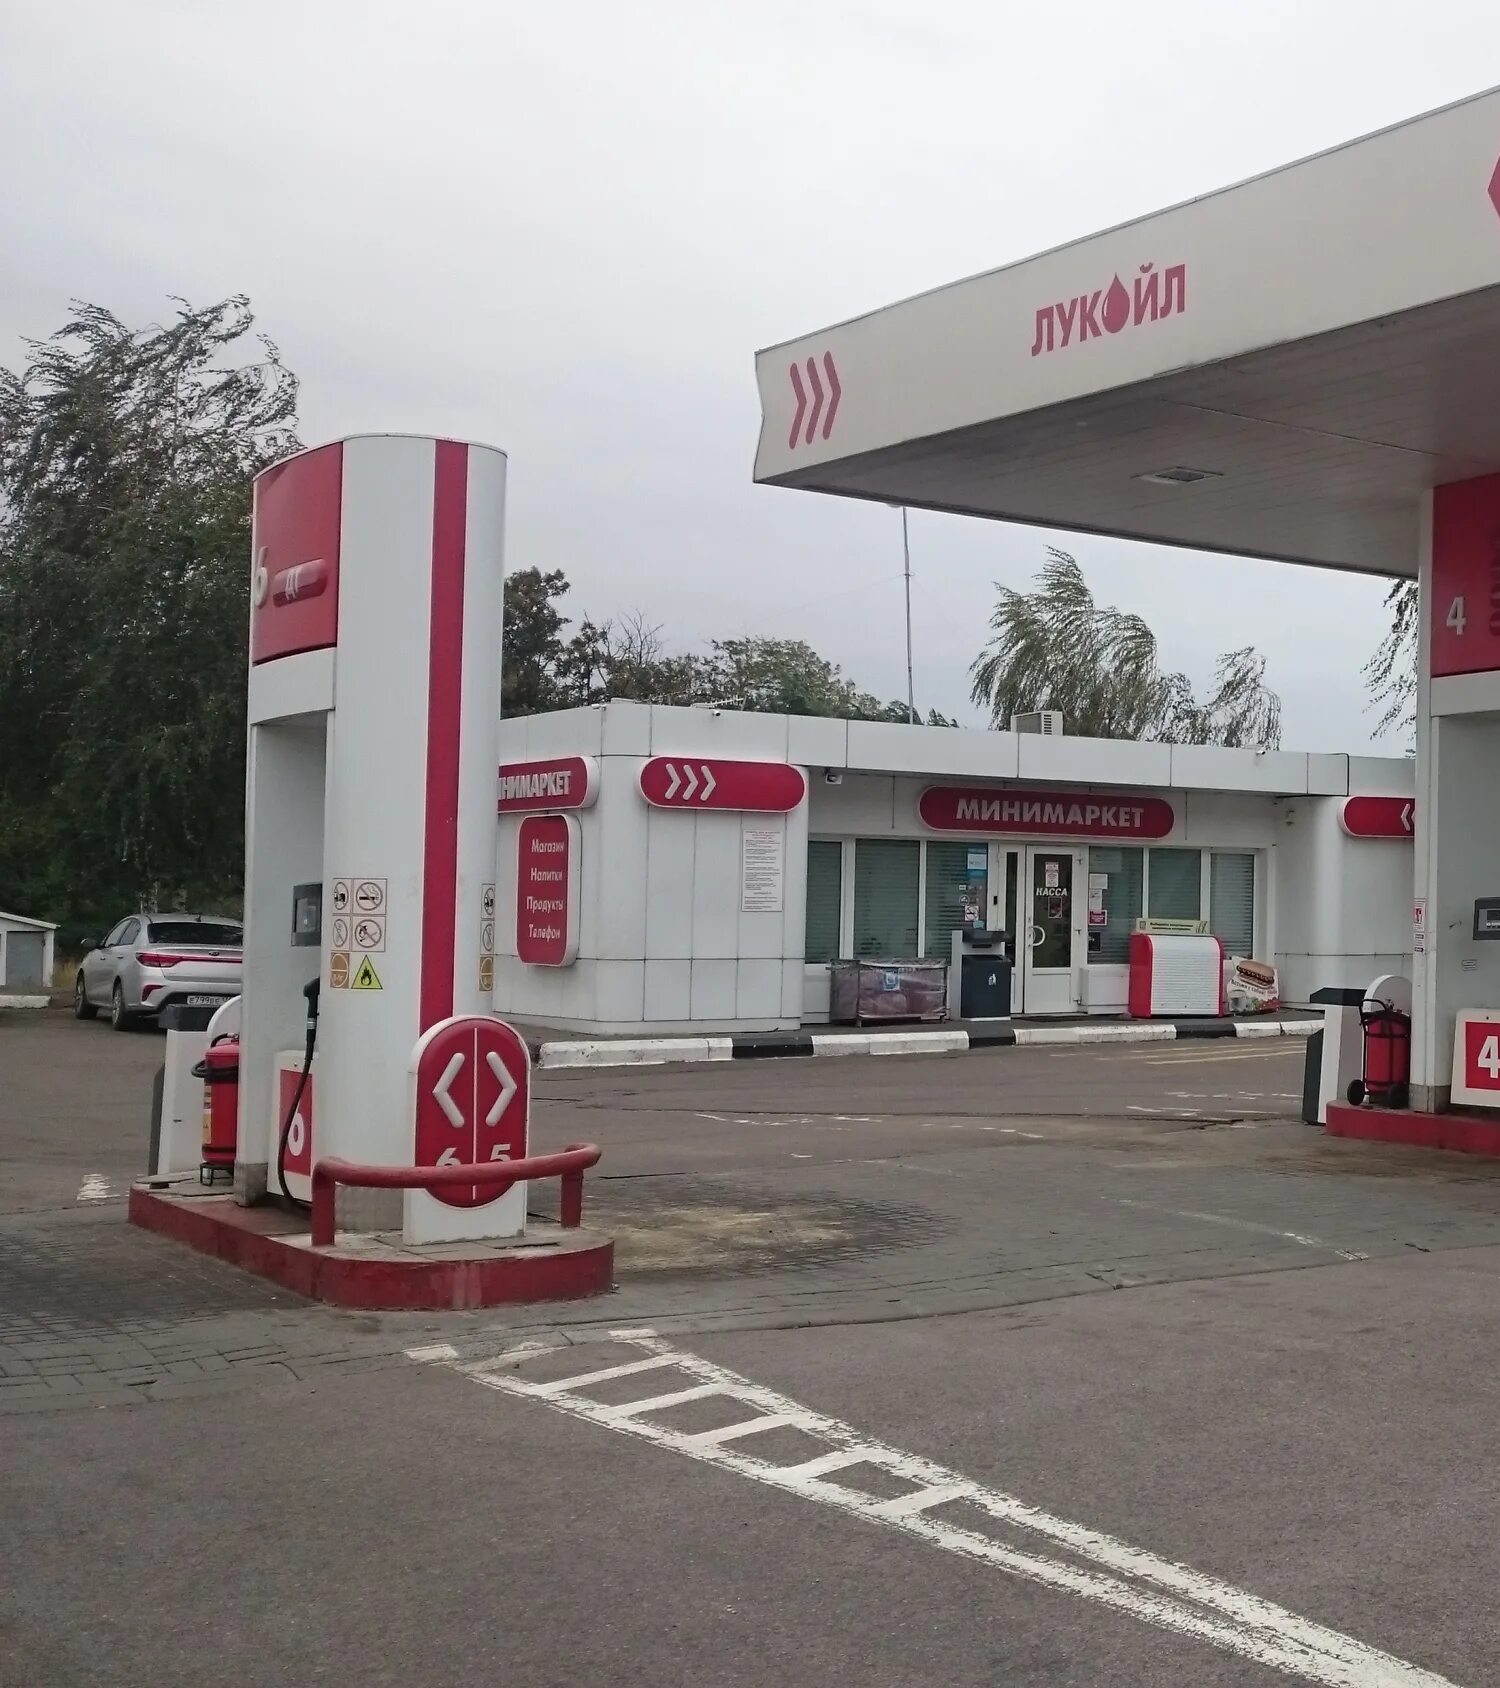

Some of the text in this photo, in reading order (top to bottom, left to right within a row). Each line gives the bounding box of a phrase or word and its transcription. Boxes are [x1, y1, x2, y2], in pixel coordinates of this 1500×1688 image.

[1031, 262, 1186, 357] ЛУКОЙЛ
[1446, 596, 1467, 635] 4
[498, 770, 572, 800] НИМАРКЕТ
[956, 798, 1145, 828] МИНИМАРКЕТ
[531, 839, 565, 854] Магазин
[530, 868, 563, 882] Напитки
[1035, 887, 1068, 897] КАССА
[526, 896, 564, 914] Продукты
[528, 924, 561, 942] Телефон
